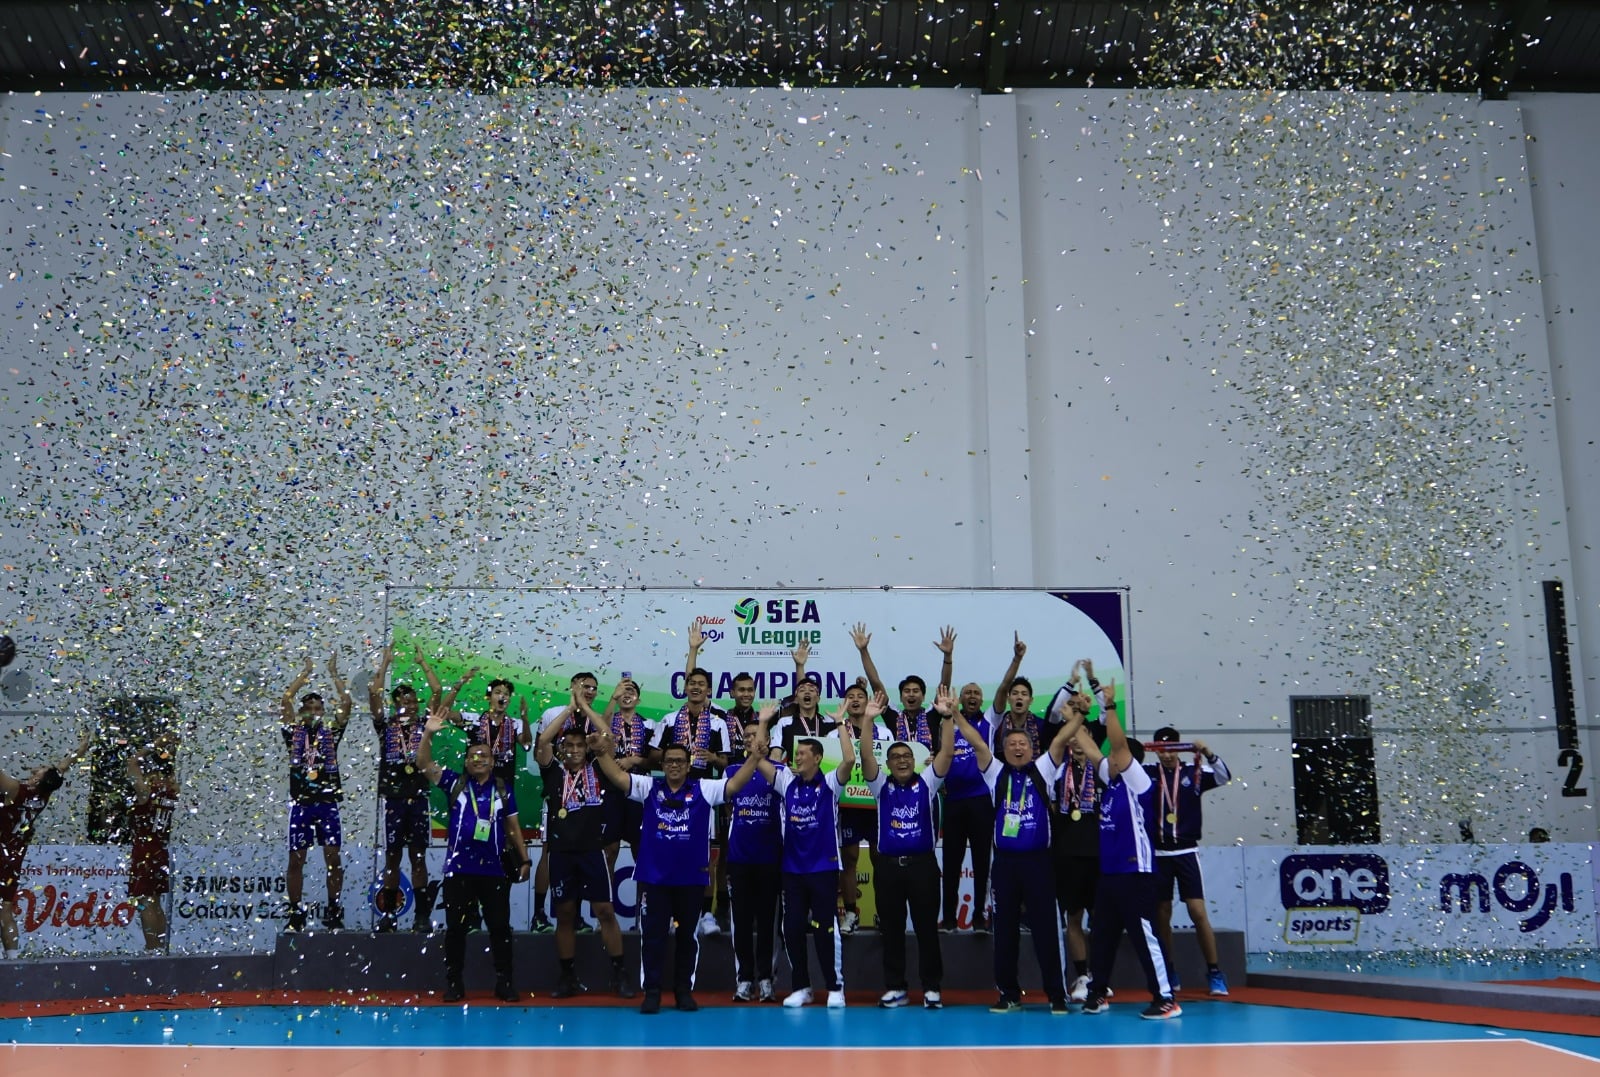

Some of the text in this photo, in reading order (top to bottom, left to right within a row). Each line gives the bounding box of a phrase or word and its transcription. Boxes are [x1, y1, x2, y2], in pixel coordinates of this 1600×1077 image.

[696, 616, 725, 625] Vidio
[767, 600, 820, 623] SEA
[738, 627, 821, 647] VLeague
[1558, 750, 1587, 797] 2
[182, 876, 286, 894] SAMSUNG
[1293, 868, 1378, 900] one
[13, 885, 136, 933] Vidio
[179, 900, 253, 920] Galaxy
[1291, 915, 1352, 934] sports
